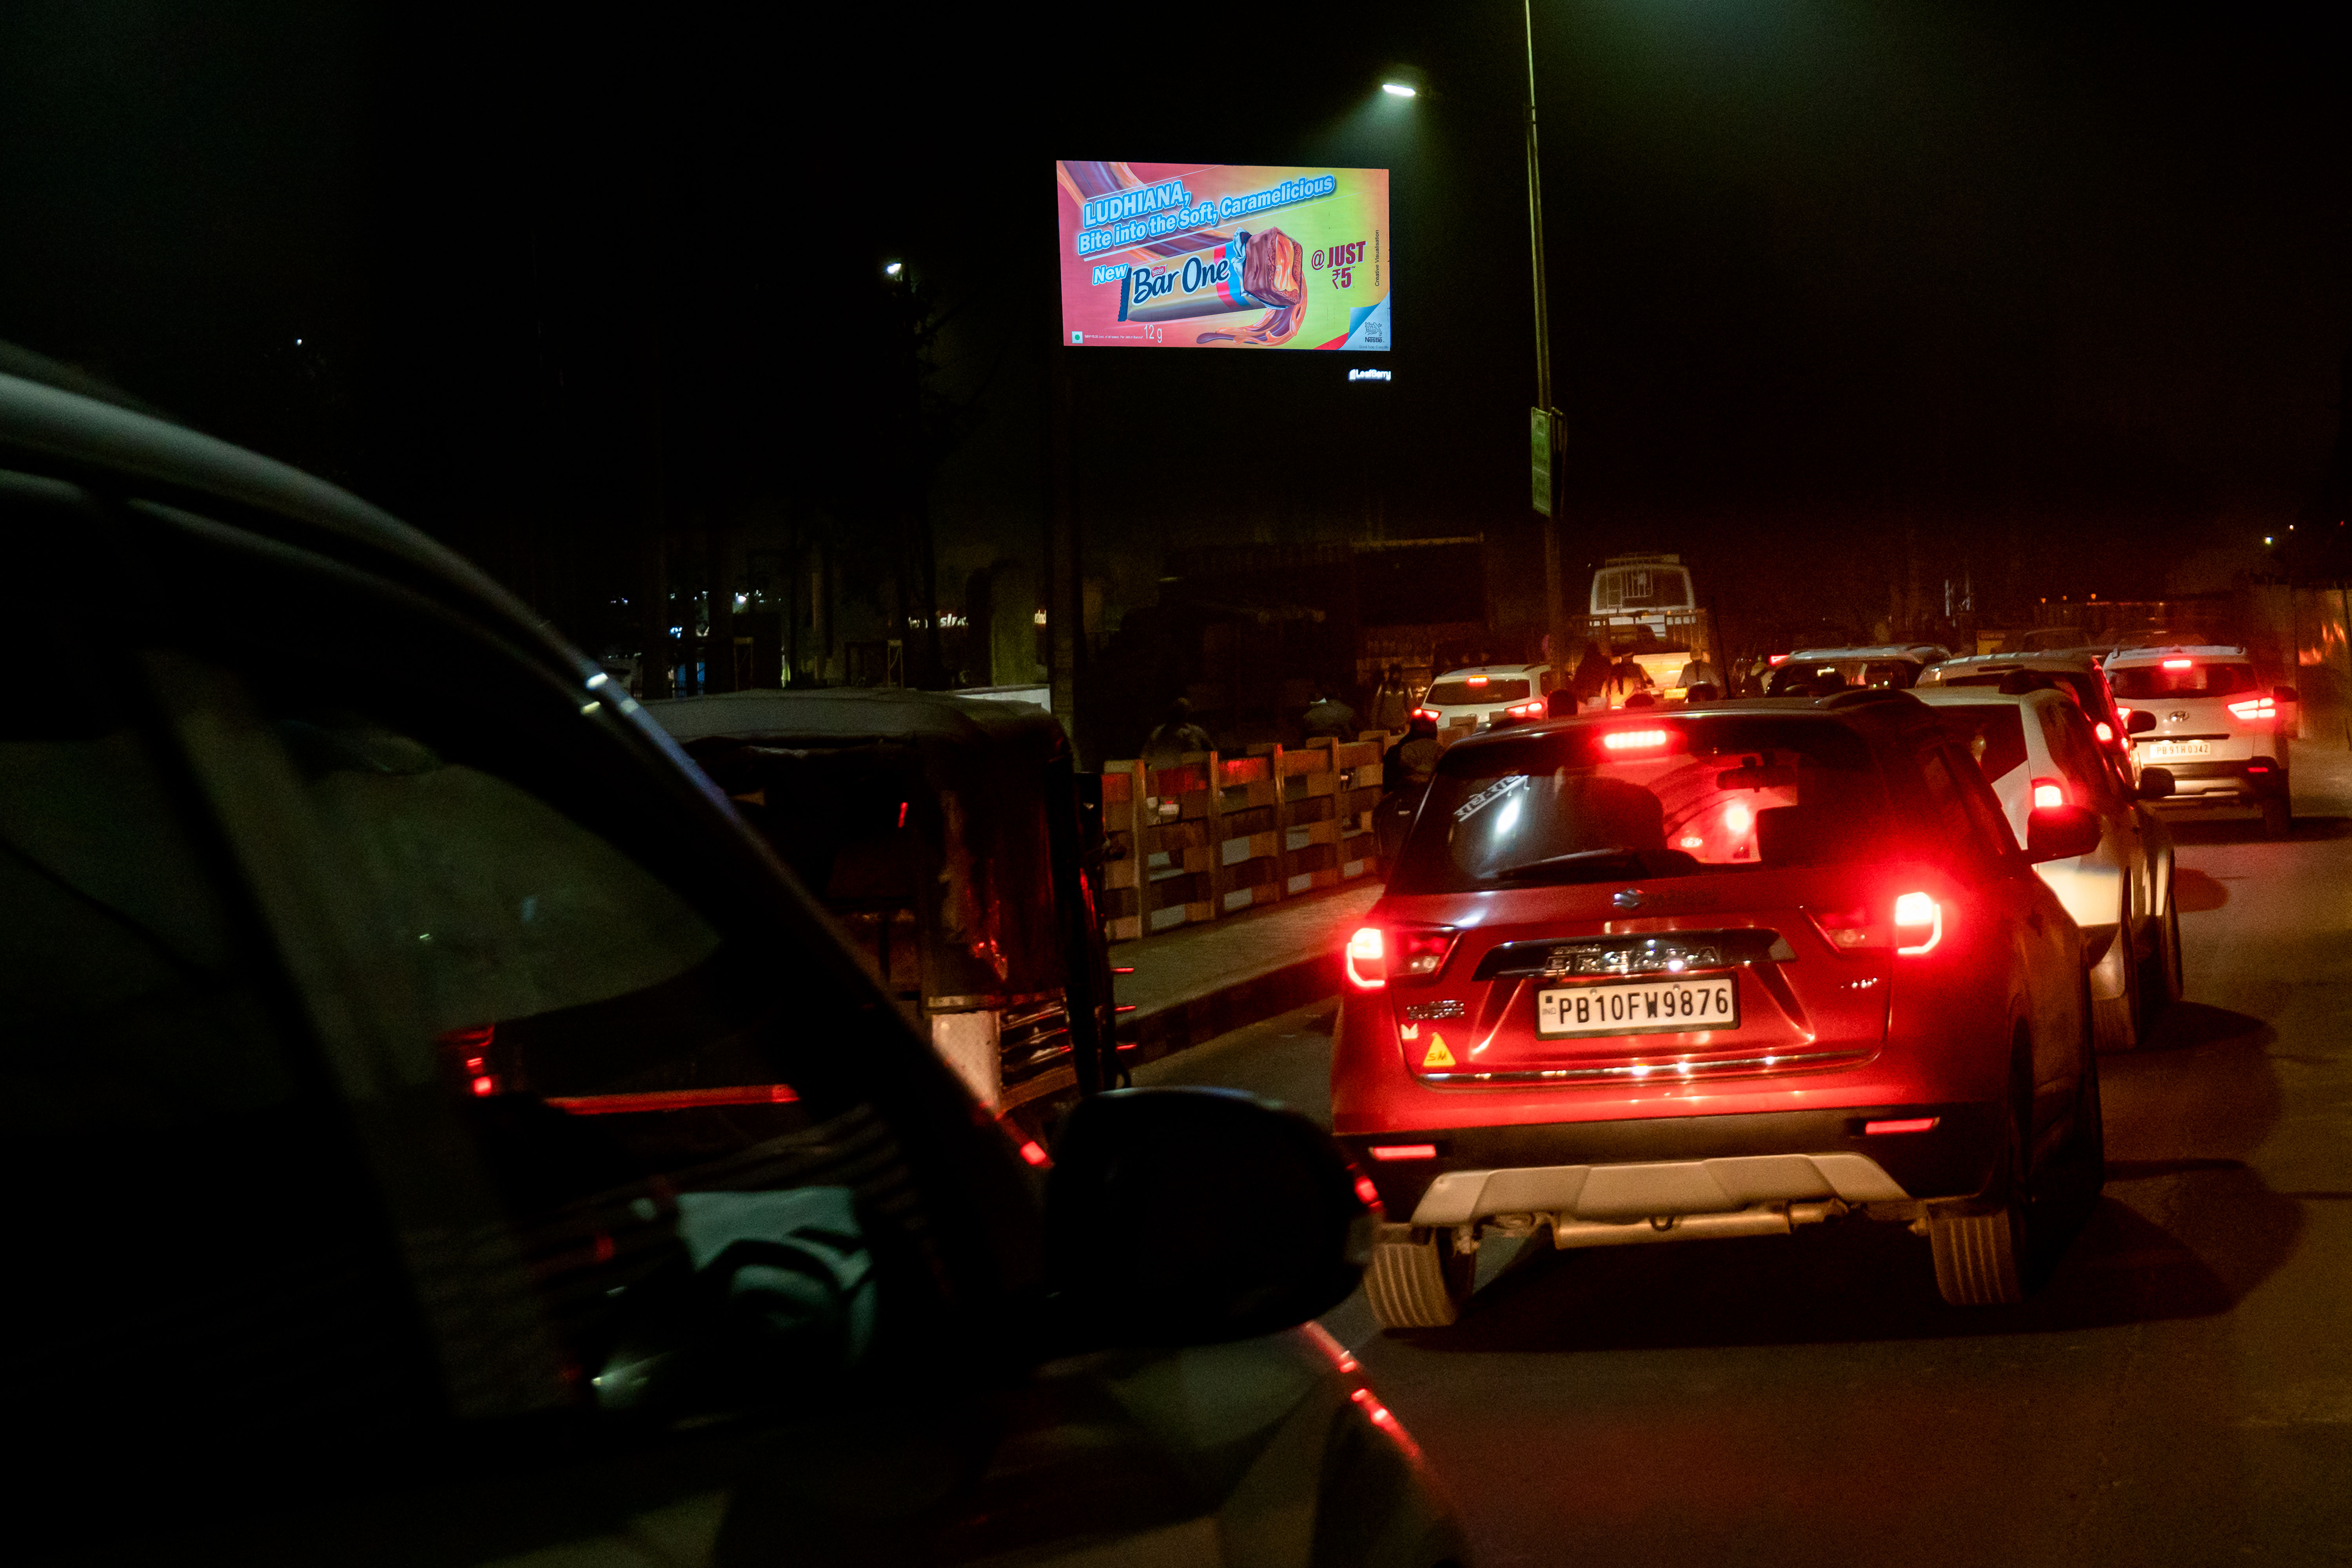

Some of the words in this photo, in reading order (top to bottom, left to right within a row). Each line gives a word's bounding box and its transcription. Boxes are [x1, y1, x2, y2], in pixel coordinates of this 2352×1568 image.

[1079, 231, 1112, 253] Bite
[1115, 222, 1146, 244] into
[1149, 216, 1177, 235] the
[1178, 203, 1218, 229] Soft,
[1221, 176, 1333, 217] Caramelicious
[1085, 182, 1190, 227] LUDHIANA,
[1312, 250, 1325, 270] @
[1327, 241, 1367, 268] JUST
[1093, 264, 1128, 285] New
[1132, 268, 1180, 304] Bar
[1182, 257, 1230, 293] One
[1144, 325, 1154, 339] 12
[1157, 328, 1162, 343] g
[1559, 987, 1728, 1024] PB10FW9876
